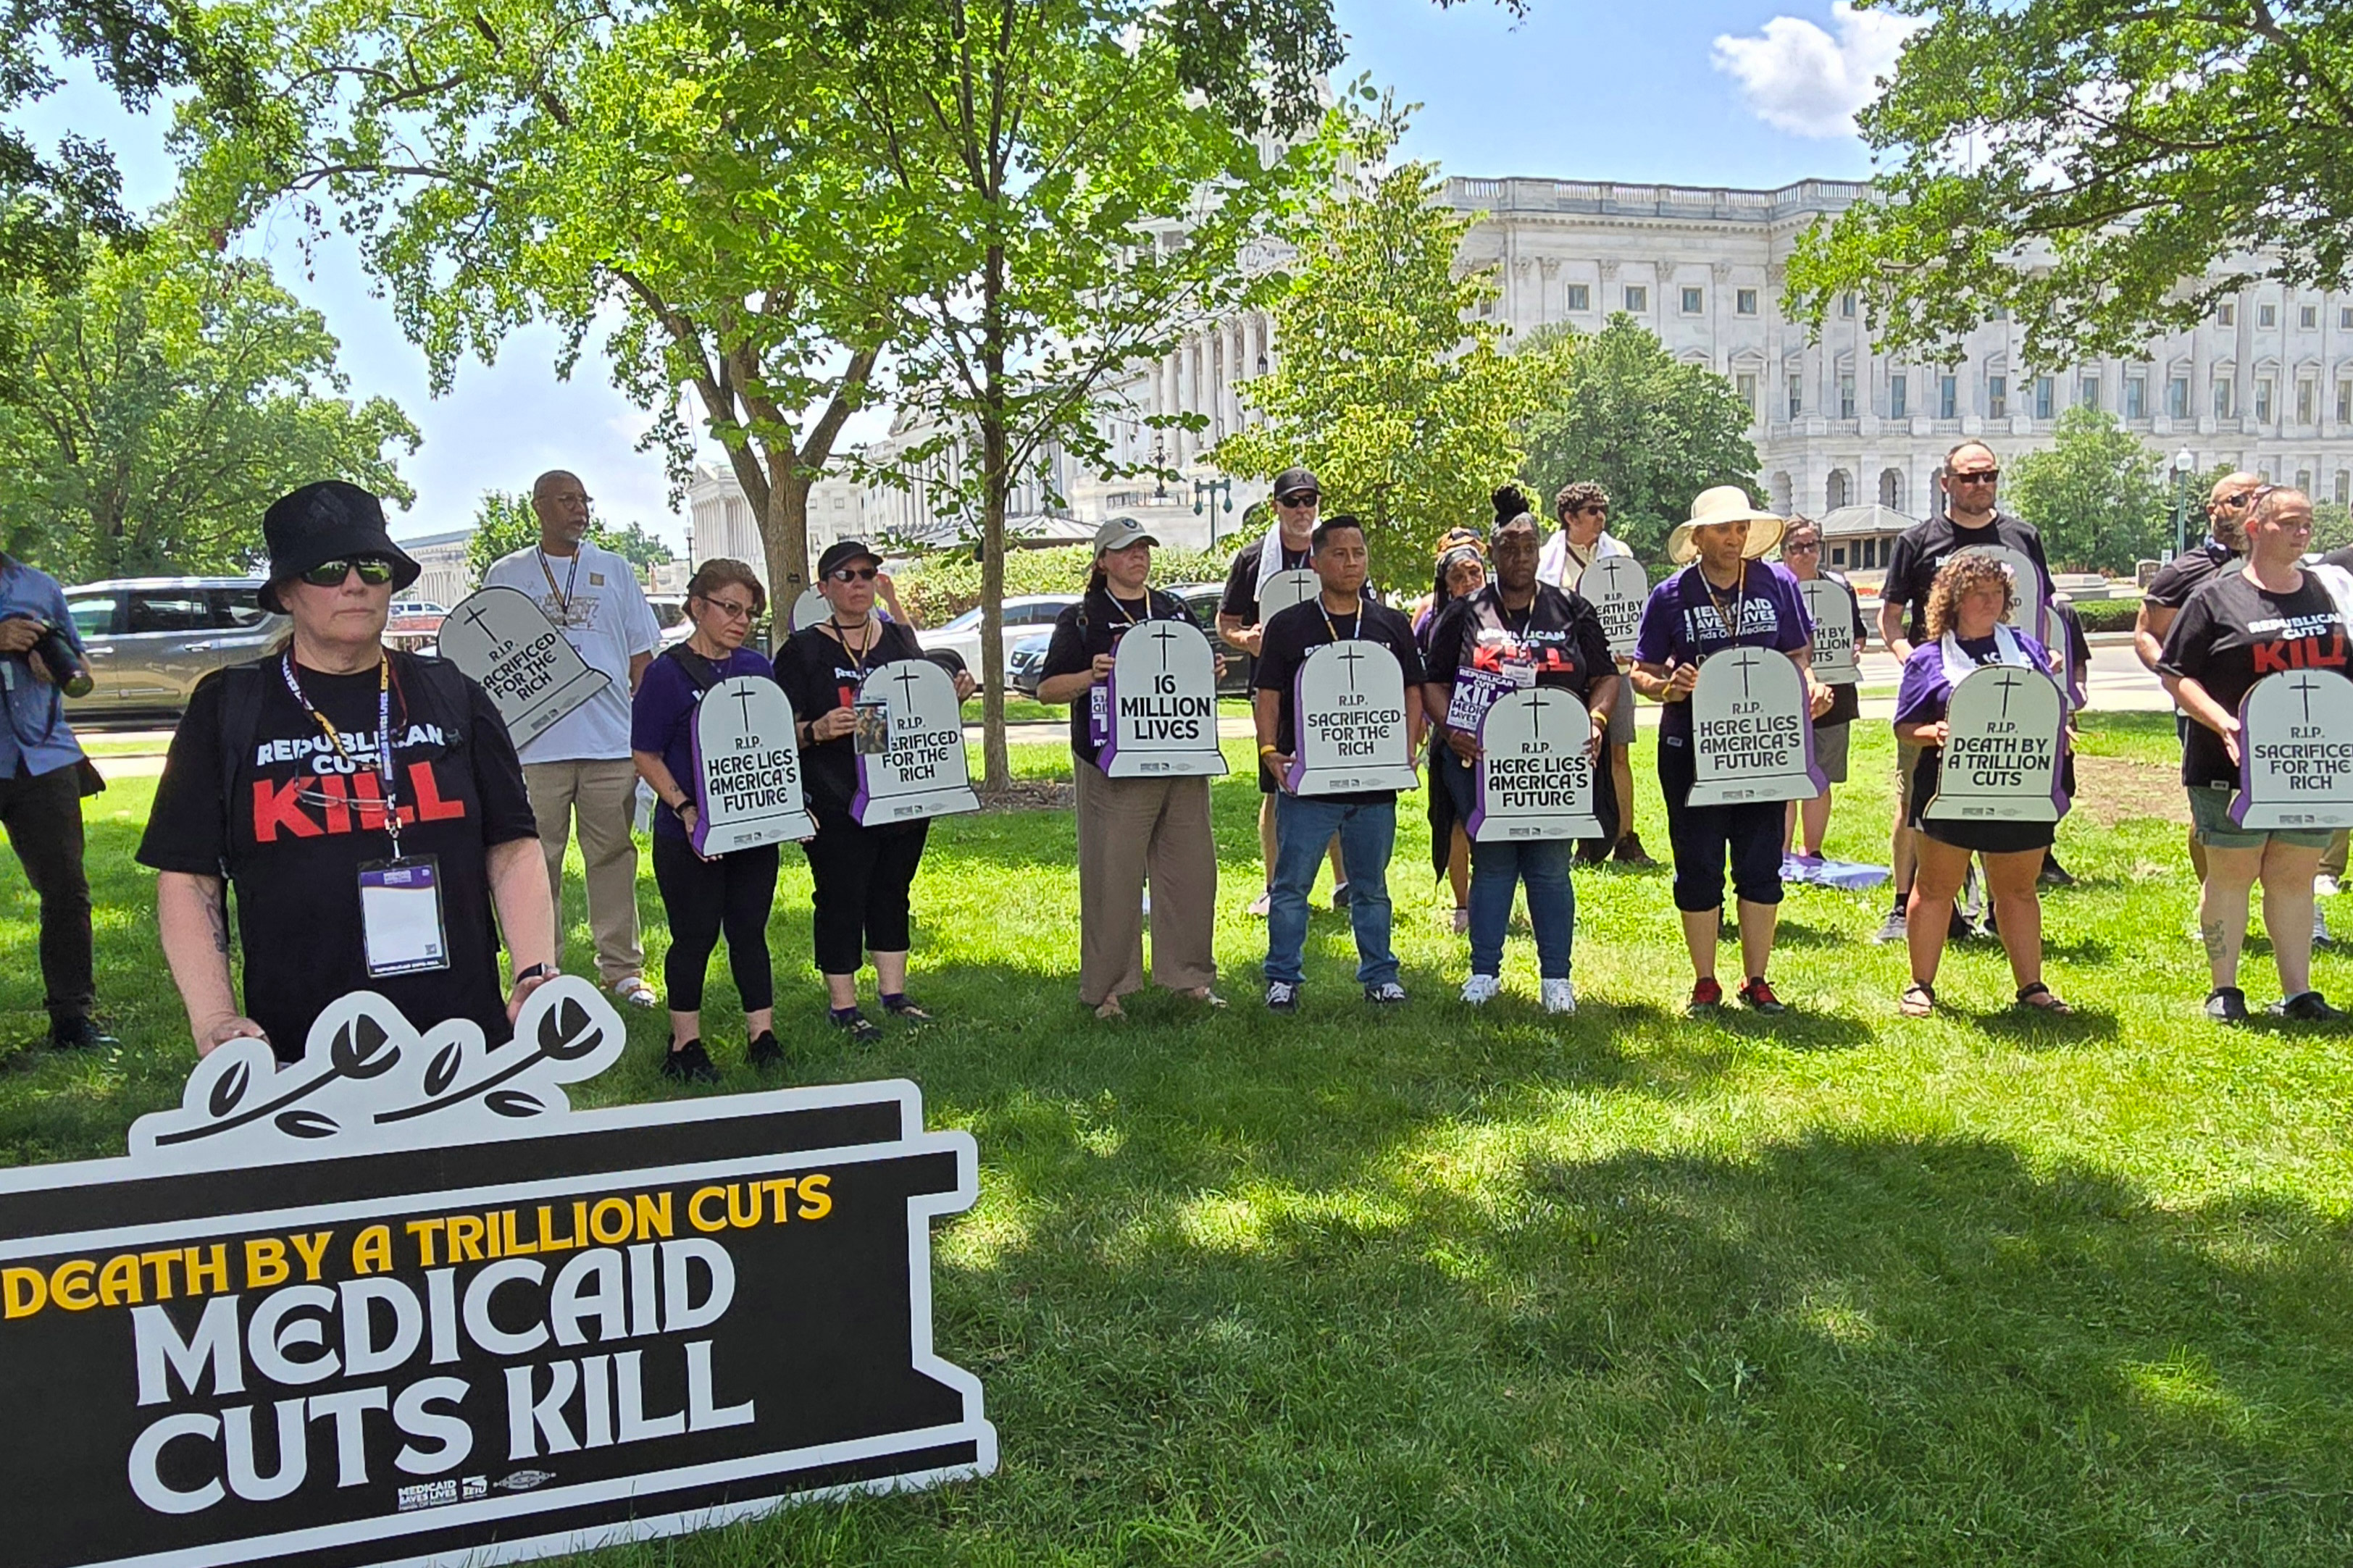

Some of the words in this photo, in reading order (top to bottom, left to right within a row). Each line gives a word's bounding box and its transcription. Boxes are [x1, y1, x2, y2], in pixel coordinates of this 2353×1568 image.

[1596, 602, 1626, 615] EATH
[1628, 600, 1643, 612] BY
[1603, 624, 1633, 637] CUTS
[1829, 626, 1846, 638] BY
[2282, 625, 2327, 640] CUTS
[488, 640, 519, 662] R.I.P.
[1500, 639, 1540, 648] CUS
[481, 632, 556, 689] ACRIFICED
[1812, 651, 1833, 663] UTS
[493, 672, 527, 700] FOR
[523, 650, 557, 676] THE
[1458, 668, 1514, 687] REPUBLICAN
[516, 671, 553, 701] RICH
[1155, 674, 1176, 695] 16
[1474, 679, 1497, 690] CUTS
[1339, 694, 1368, 707] R.I.P.
[1453, 682, 1503, 707] KIL
[1121, 697, 1211, 717] MILLION
[1451, 700, 1486, 715] MEDIC
[1732, 702, 1763, 715] R.I.P.
[898, 716, 926, 730] R.I.P.
[1308, 710, 1400, 727] SACRIFICED
[1700, 719, 1751, 737] HERE
[1756, 715, 1797, 734] LIES
[1134, 720, 1199, 739] LIVES
[1321, 727, 1354, 742] FOR
[1358, 725, 1389, 739] THE
[1986, 722, 2018, 734] R.I.P.
[2291, 726, 2325, 739] R.I.P.
[735, 736, 764, 750] R.I.P.
[1338, 741, 1374, 756] RICH
[1522, 742, 1552, 754] R.I.P.
[1700, 732, 1800, 754] AMERICA'S
[1953, 737, 2017, 753] DEATH
[2021, 738, 2048, 753] BY
[2254, 743, 2353, 759] SACRIFICE
[709, 755, 754, 776] HERE
[757, 749, 793, 769] LIES
[882, 751, 914, 768] FOR
[917, 747, 948, 764] THE
[1489, 758, 1540, 774] HERE
[1545, 756, 1586, 773] LIES
[1714, 750, 1788, 771] FUTURE
[1948, 754, 1960, 769] A
[1965, 755, 2050, 771] TRILLION
[900, 764, 935, 782] RICH
[2270, 760, 2308, 775] FOR
[2314, 760, 2352, 774] THE
[710, 767, 796, 796] AMERICA'S
[1489, 773, 1588, 791] AMERICA'S
[1972, 771, 2022, 786] CUTS
[2290, 775, 2332, 790] RICH
[253, 760, 465, 842] KILL
[724, 787, 787, 813] FUTURE
[1503, 791, 1576, 808] FUTURE
[1, 1244, 230, 1319] DEATH
[244, 1230, 333, 1288] BY
[352, 1225, 394, 1275] A
[406, 1191, 674, 1267] TRILLION
[688, 1174, 832, 1232] CUTS
[130, 1237, 735, 1406] MEDICAID
[128, 1376, 474, 1515] CUTS
[504, 1339, 756, 1462] KILL
[398, 1480, 457, 1495] MEDICAID
[430, 1488, 457, 1501] LIVES
